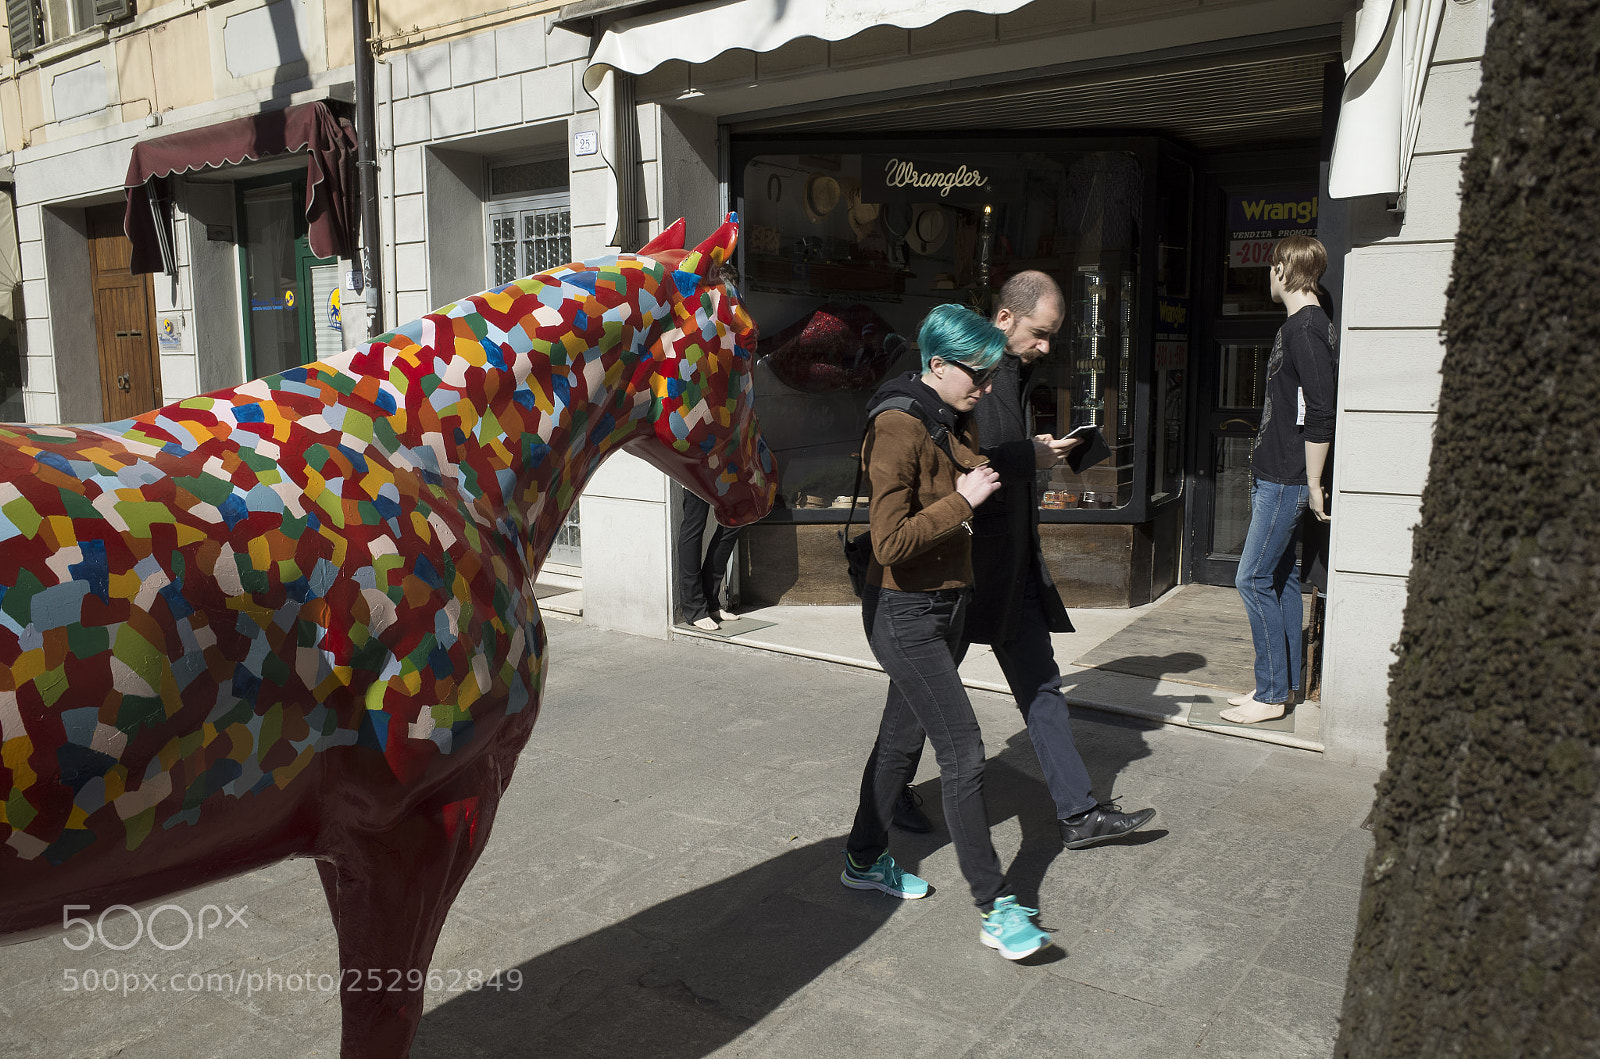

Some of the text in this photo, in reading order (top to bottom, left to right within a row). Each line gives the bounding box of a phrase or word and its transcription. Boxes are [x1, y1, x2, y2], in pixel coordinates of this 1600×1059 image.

[580, 138, 591, 150] 25
[884, 157, 990, 197] Wrangler
[1240, 197, 1319, 224] Wrangl
[1232, 230, 1273, 240] VENDITA
[1235, 241, 1274, 264] -20%
